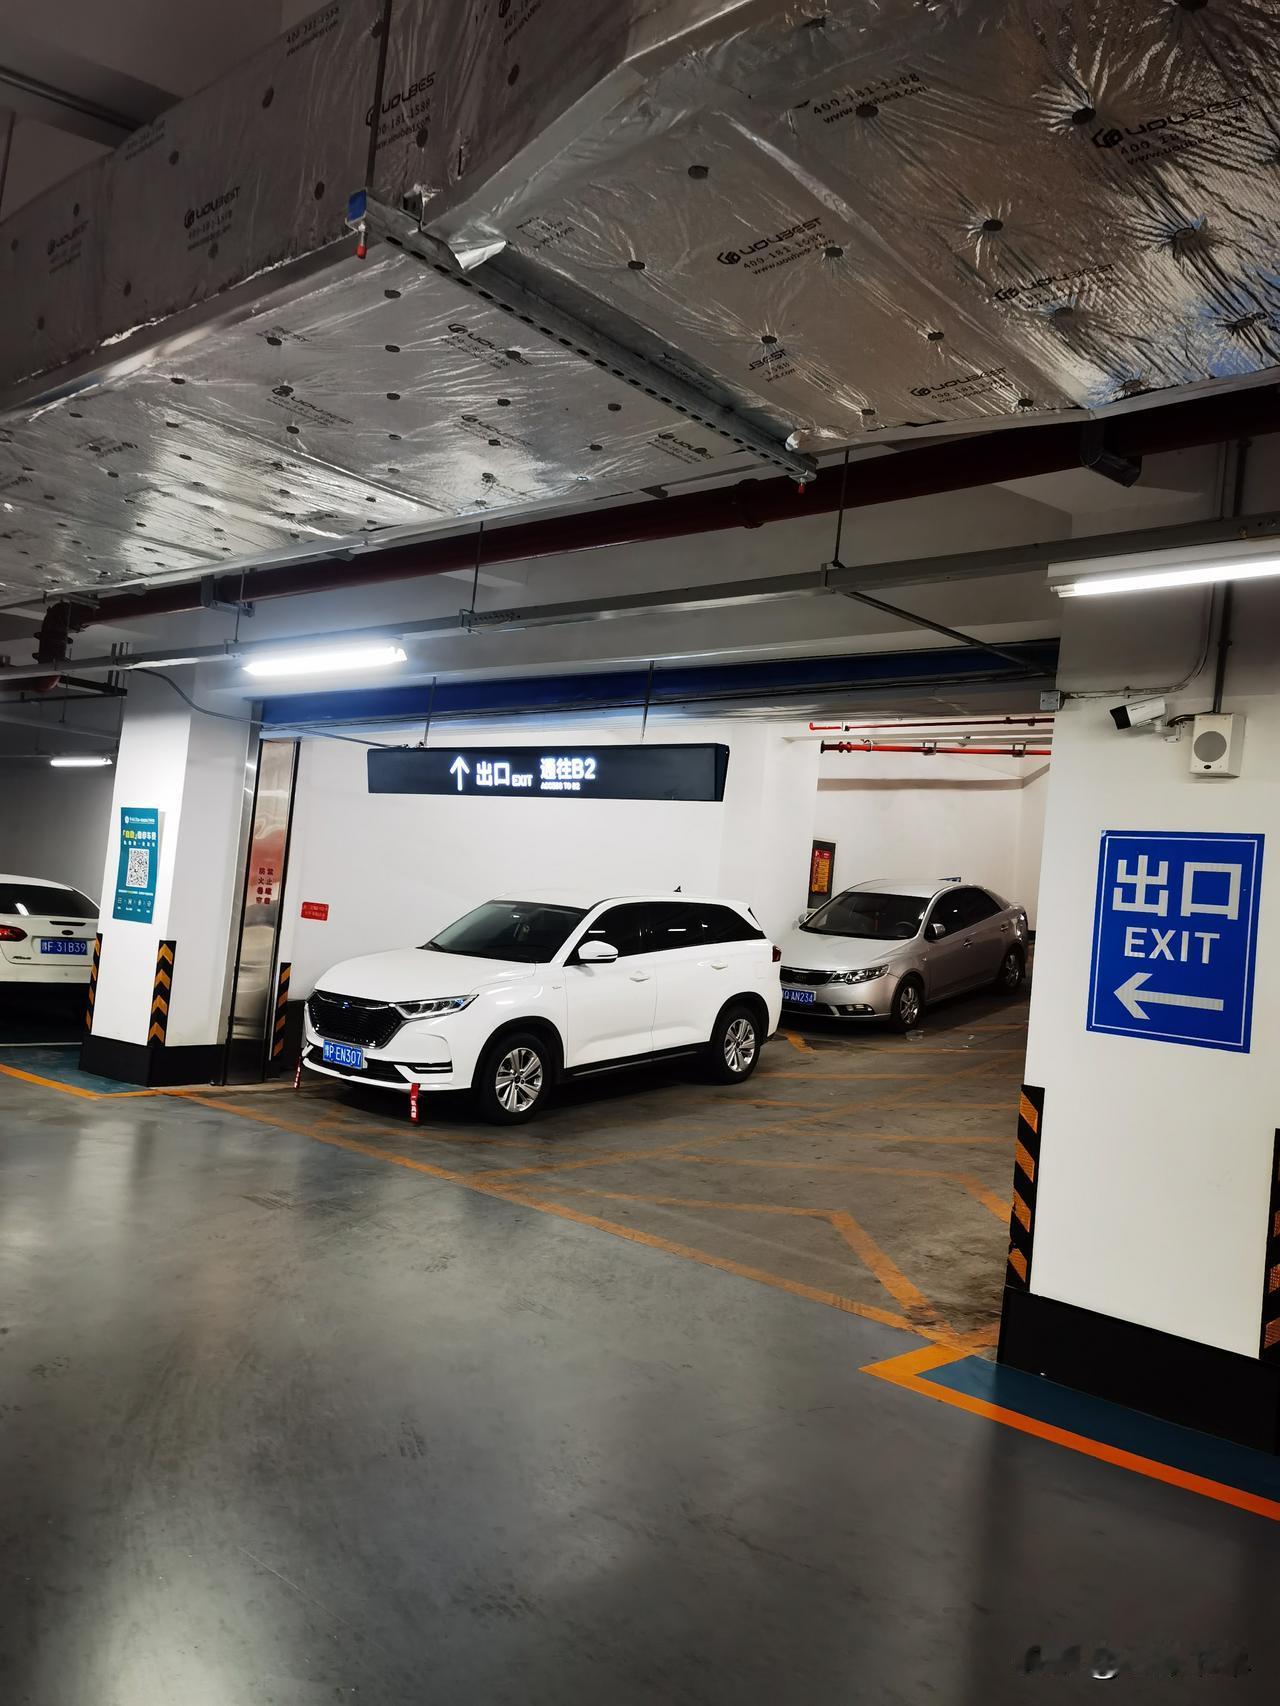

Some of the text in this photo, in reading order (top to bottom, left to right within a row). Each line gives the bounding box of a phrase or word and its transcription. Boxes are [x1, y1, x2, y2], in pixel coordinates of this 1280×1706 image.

[739, 217, 822, 255] UOUBEST
[476, 757, 596, 787] 出口 EXIT 通往B2
[1112, 854, 1243, 921] 出口
[1124, 926, 1221, 965] EXIT
